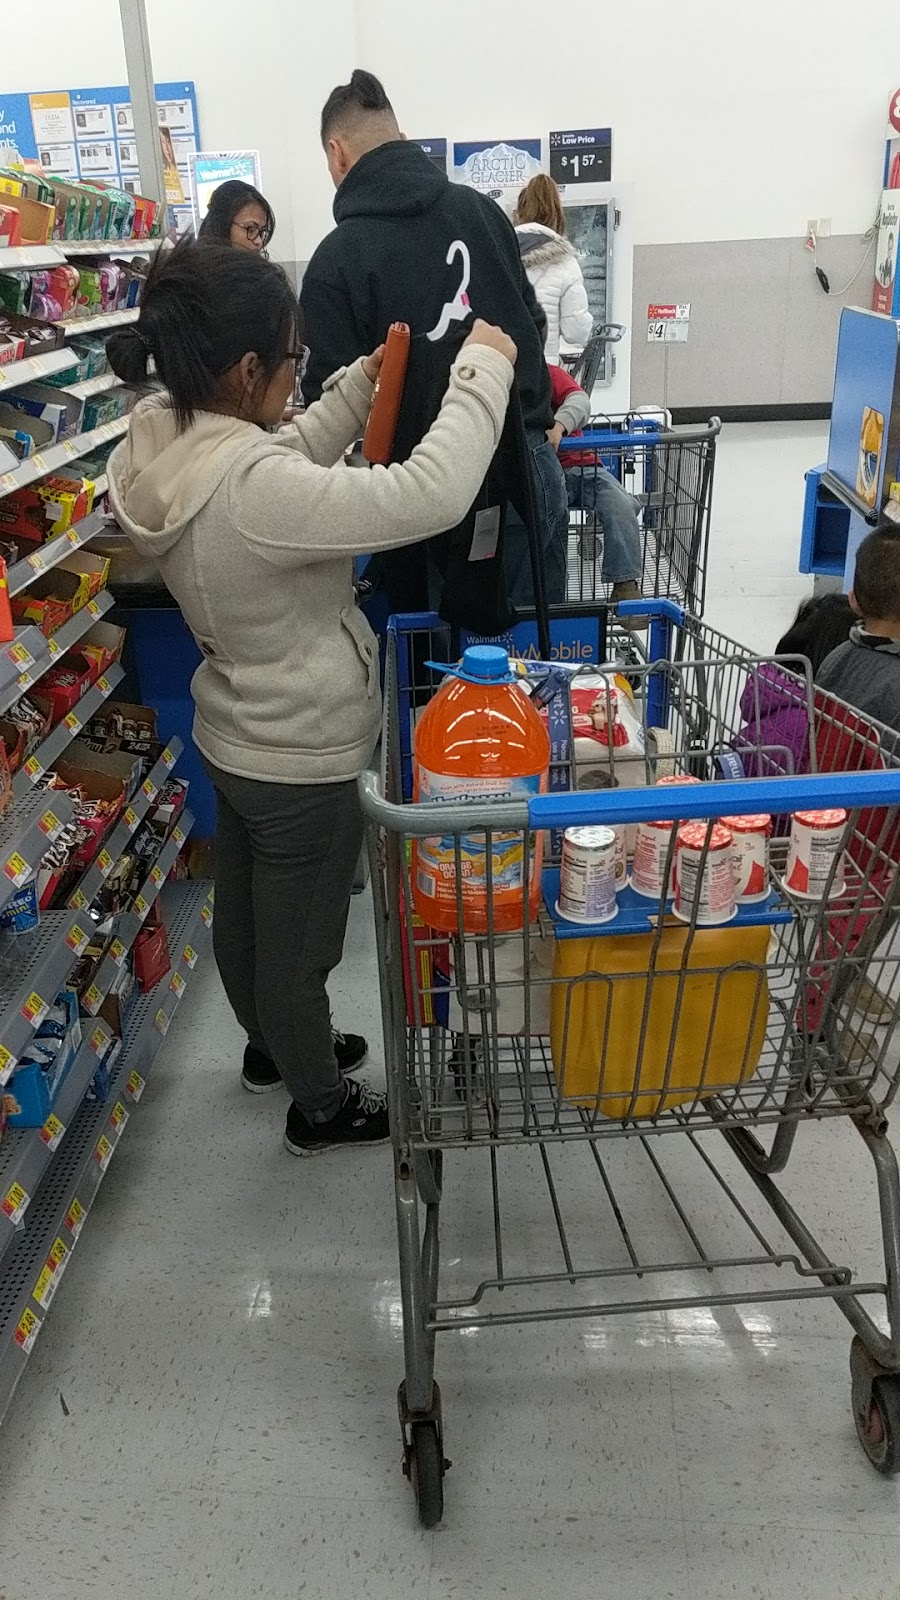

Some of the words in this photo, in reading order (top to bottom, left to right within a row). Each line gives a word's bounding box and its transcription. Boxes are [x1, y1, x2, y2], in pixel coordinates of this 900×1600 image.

[562, 137, 577, 145] Low
[577, 135, 596, 144] Price
[470, 153, 526, 172] ARCTIC
[471, 170, 526, 184] GLACIER
[466, 635, 502, 644] Walmart
[439, 861, 472, 872] ORAGE
[443, 869, 471, 879] OCN
